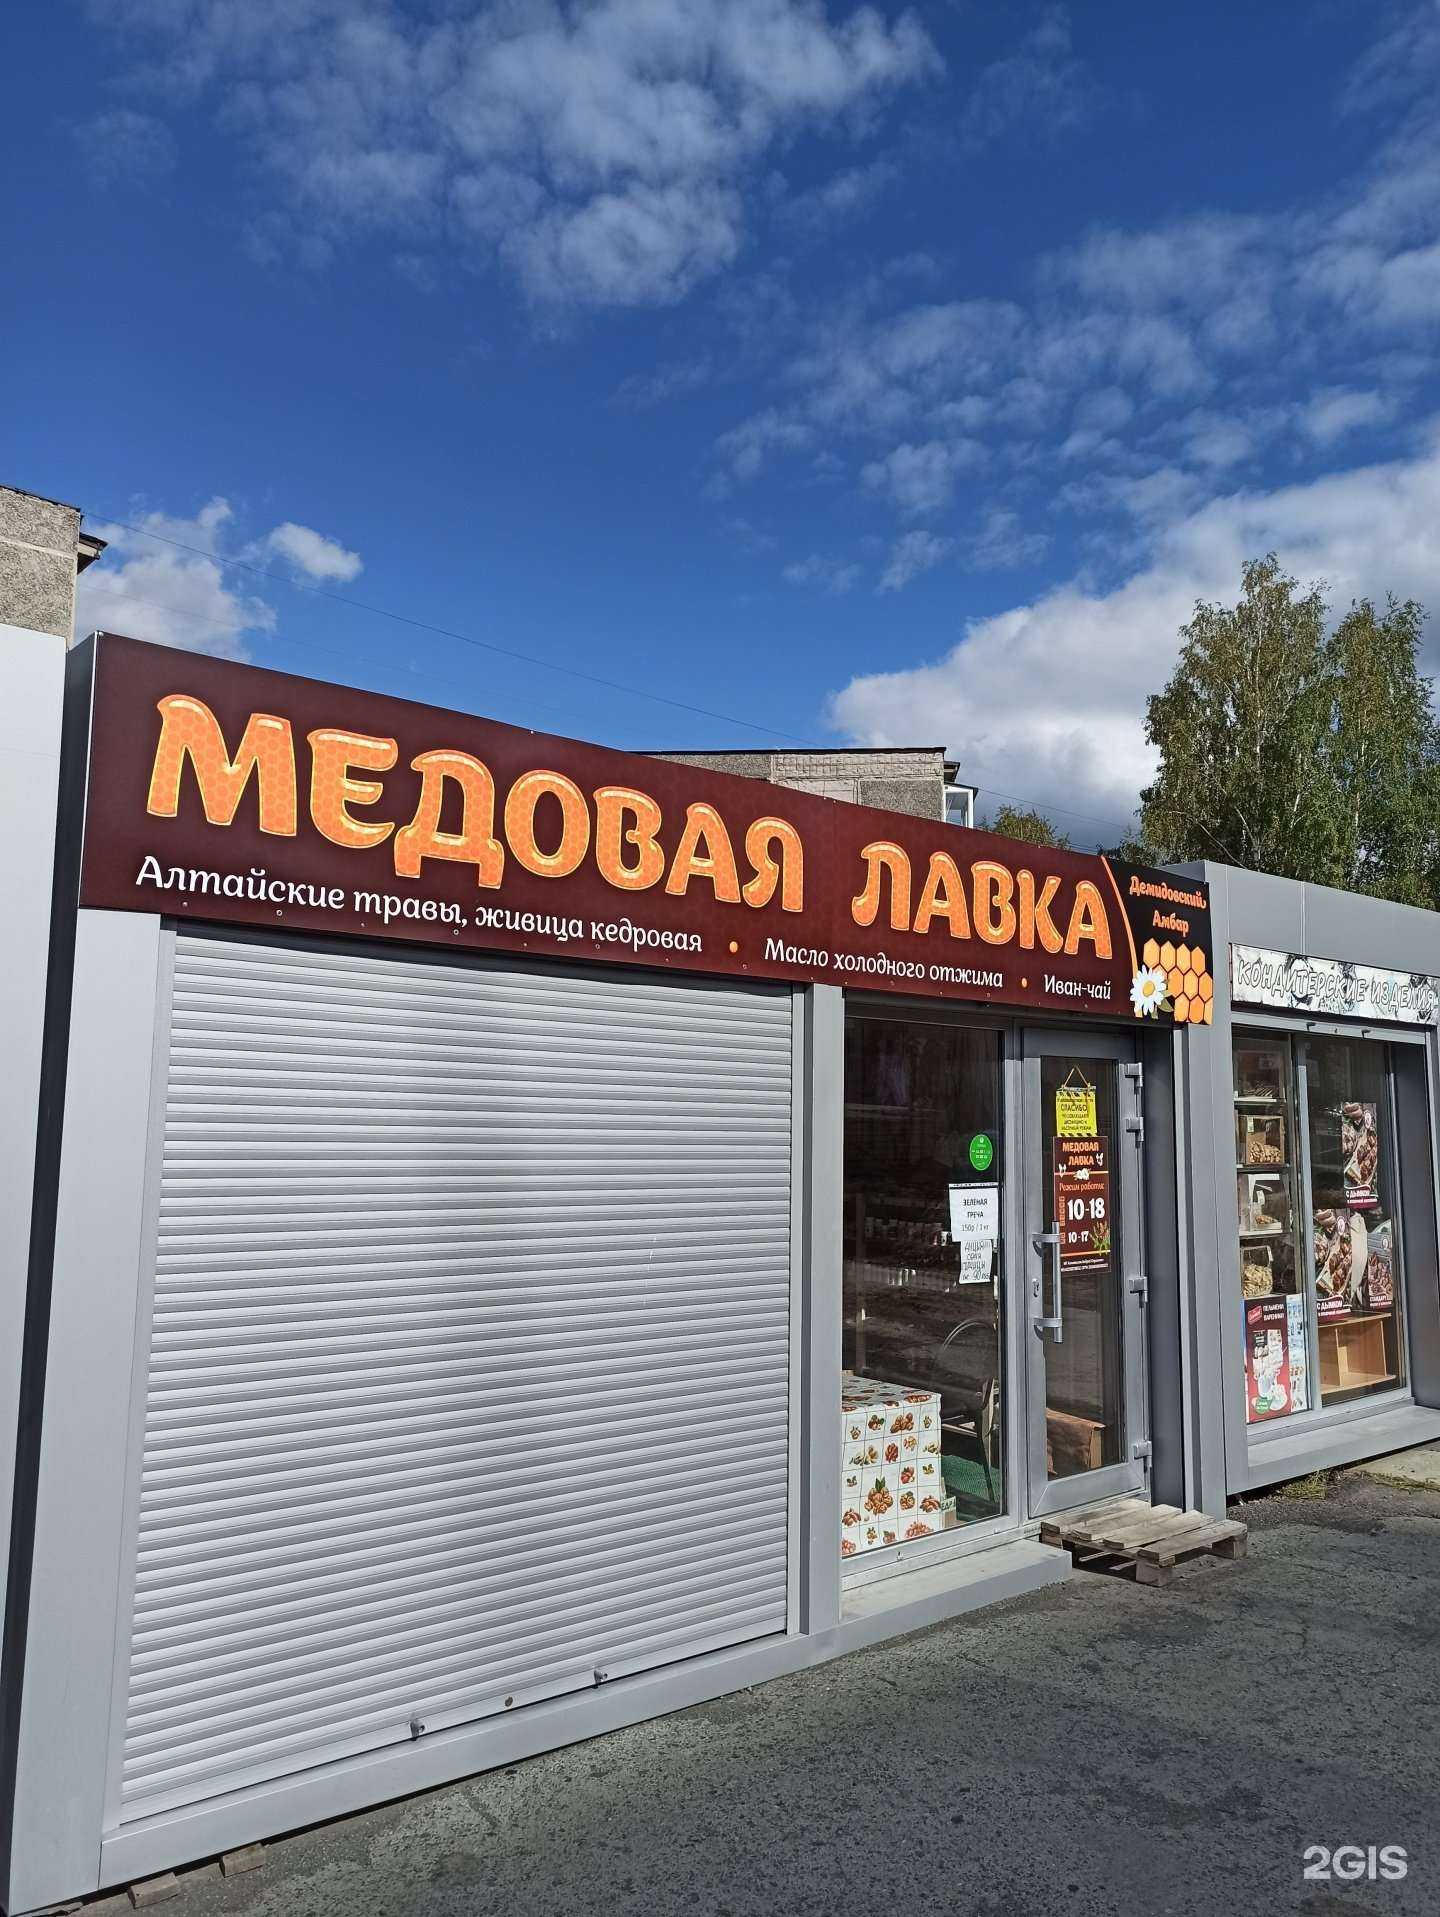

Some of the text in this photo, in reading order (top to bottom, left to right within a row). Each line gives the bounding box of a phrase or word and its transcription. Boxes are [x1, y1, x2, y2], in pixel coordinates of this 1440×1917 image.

[146, 694, 1113, 960] МЕДОВАЯ ЛАВКА
[1129, 875, 1207, 909] Демидовский
[135, 855, 1112, 1000] Алтайские травы, живица кедровая Масло холодного отжима Иван-чай
[1152, 909, 1190, 938] Амбар
[1237, 959, 1433, 1012] КОНДИТЕРСКИЕ ИЗДЕЛИЯ
[1062, 1141, 1099, 1154] МЕДОВАЯ
[1068, 1155, 1095, 1166] ЛАВКА
[1067, 1197, 1106, 1221] 10-18
